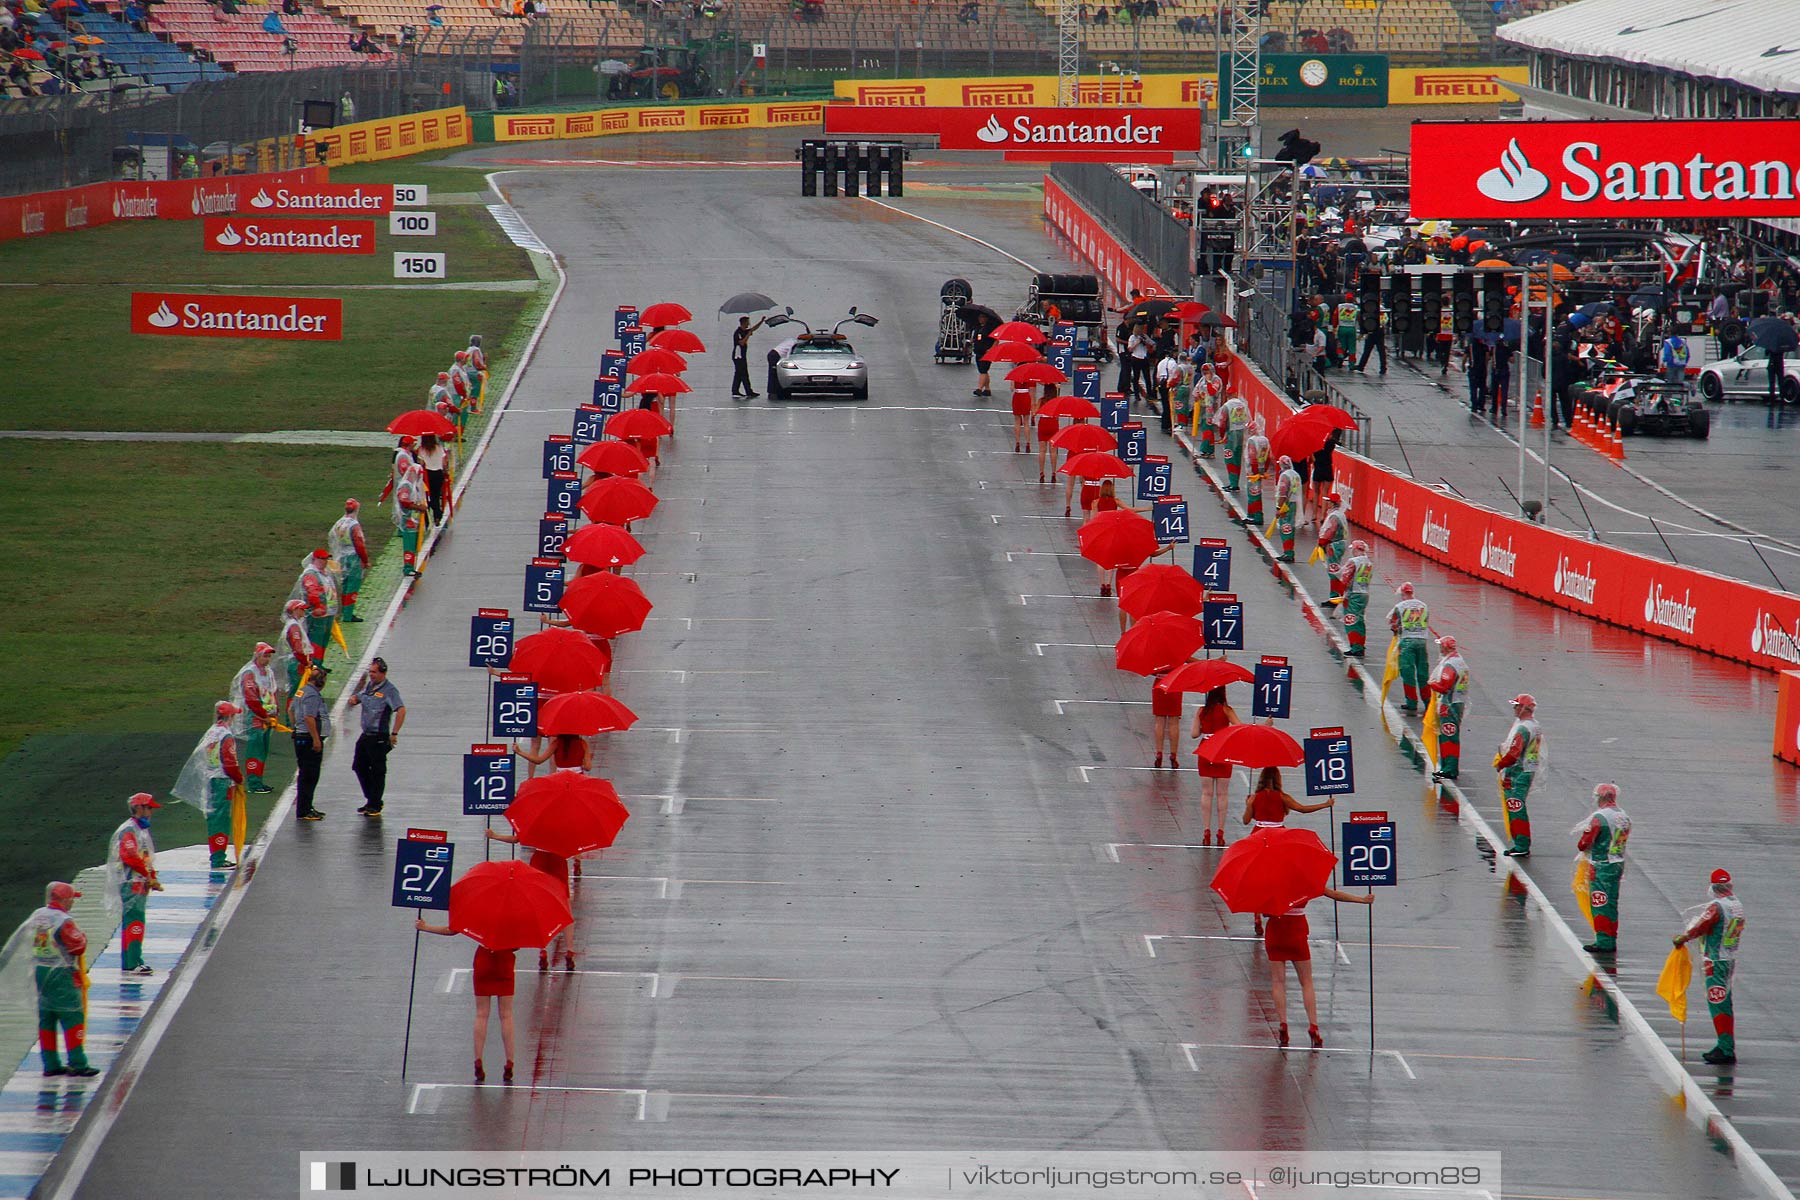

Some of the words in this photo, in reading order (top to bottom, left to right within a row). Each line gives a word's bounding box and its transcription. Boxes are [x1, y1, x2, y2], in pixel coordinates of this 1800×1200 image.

[1339, 77, 1377, 86] ROLEX
[1415, 74, 1498, 96] PIRELLI
[858, 86, 926, 107] PIRELLI
[962, 84, 1034, 106] PIRELLI
[601, 112, 629, 130] PIRELLI
[639, 109, 685, 127] PIRELLI
[700, 108, 749, 125] PIRELLI
[767, 105, 822, 123] PIRELLI
[400, 121, 416, 146] PIRELLI
[422, 118, 439, 143] PIRELLI
[446, 114, 462, 139] PIRELLI
[508, 118, 555, 135] PIRELLI
[566, 115, 593, 133] PIRELLI
[1012, 115, 1163, 144] Santander
[375, 126, 392, 151] PIRELLI
[1561, 141, 1800, 202] Santan
[120, 187, 157, 217] Santander
[200, 183, 238, 214] Santander
[276, 188, 383, 210] Santander
[395, 189, 416, 201] 50
[396, 216, 429, 231] 100
[244, 225, 362, 248] Santander
[401, 258, 437, 274] 150
[183, 303, 327, 333] Santander
[626, 342, 642, 355] 15
[1054, 356, 1065, 370] 3
[1082, 381, 1092, 395] 7
[599, 393, 618, 408] 10
[1110, 410, 1118, 424] 1
[577, 422, 597, 438] 21
[1127, 441, 1138, 456] 8
[549, 455, 570, 471] 16
[1145, 475, 1166, 492] 19
[558, 492, 571, 509] 9
[1161, 516, 1184, 534] 14
[1427, 509, 1450, 553] Santander
[544, 535, 564, 553] 22
[1486, 531, 1517, 578] Santander
[1204, 562, 1219, 580] 4
[1561, 556, 1596, 605] Santander
[537, 582, 552, 601] 5
[1653, 583, 1697, 635] Santander
[1211, 619, 1237, 638] 17
[476, 635, 508, 656] 26
[1260, 683, 1281, 705] 11
[499, 702, 532, 724] 25
[1314, 757, 1346, 781] 18
[473, 775, 507, 800] 12
[416, 832, 444, 841] Santander
[1350, 845, 1391, 871] 20
[401, 864, 445, 893] 27
[414, 895, 433, 903] ROSSI
